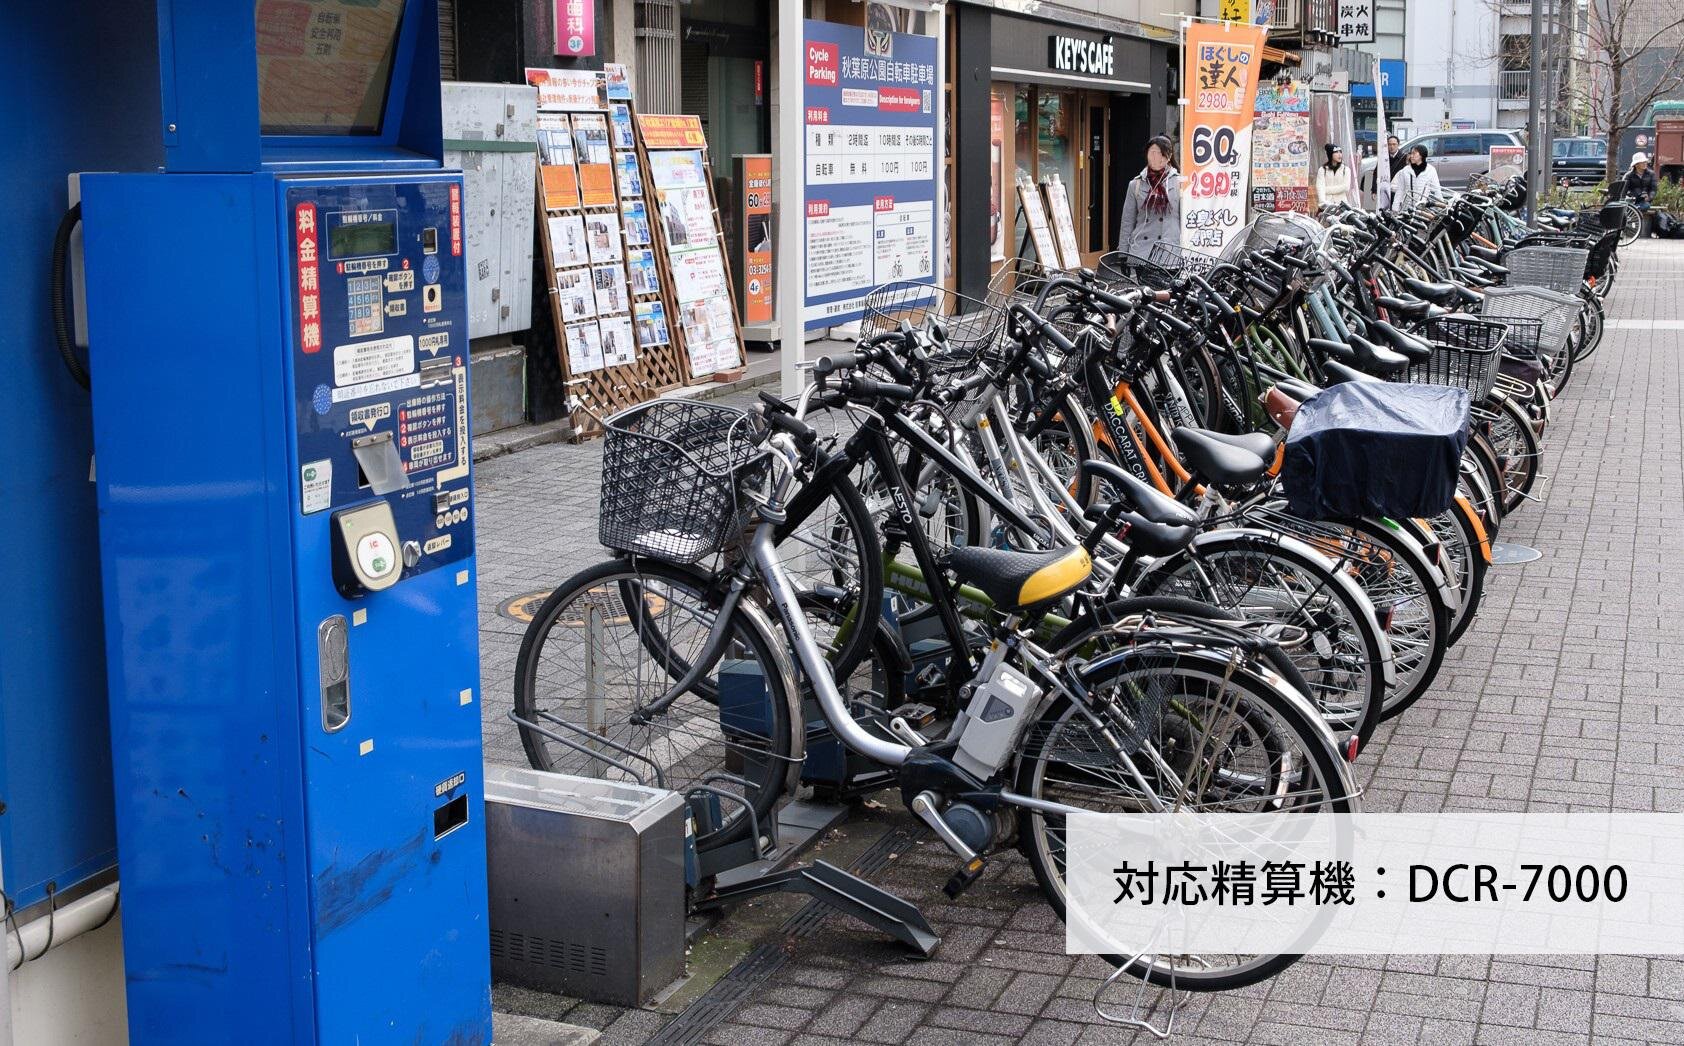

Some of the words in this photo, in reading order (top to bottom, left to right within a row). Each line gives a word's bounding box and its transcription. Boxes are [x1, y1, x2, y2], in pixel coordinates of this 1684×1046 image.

[1341, 5, 1368, 18] 炭火
[1341, 23, 1369, 36] 串焼
[809, 47, 829, 61] Cycle
[1200, 46, 1250, 65] ほぐしの
[809, 65, 836, 83] Parking
[841, 55, 934, 86] 秋葉原公園自転車駐車場
[1200, 60, 1240, 89] 達人
[808, 109, 828, 122] 利用料金
[1192, 126, 1239, 165] 60分
[815, 163, 834, 176] 自転車
[881, 162, 899, 174] 100円
[911, 161, 928, 173] 100円
[298, 208, 322, 349] 料金精算機
[351, 405, 389, 422] 領収書発行口
[891, 486, 912, 523] NESTO
[782, 602, 800, 640] Panasonic
